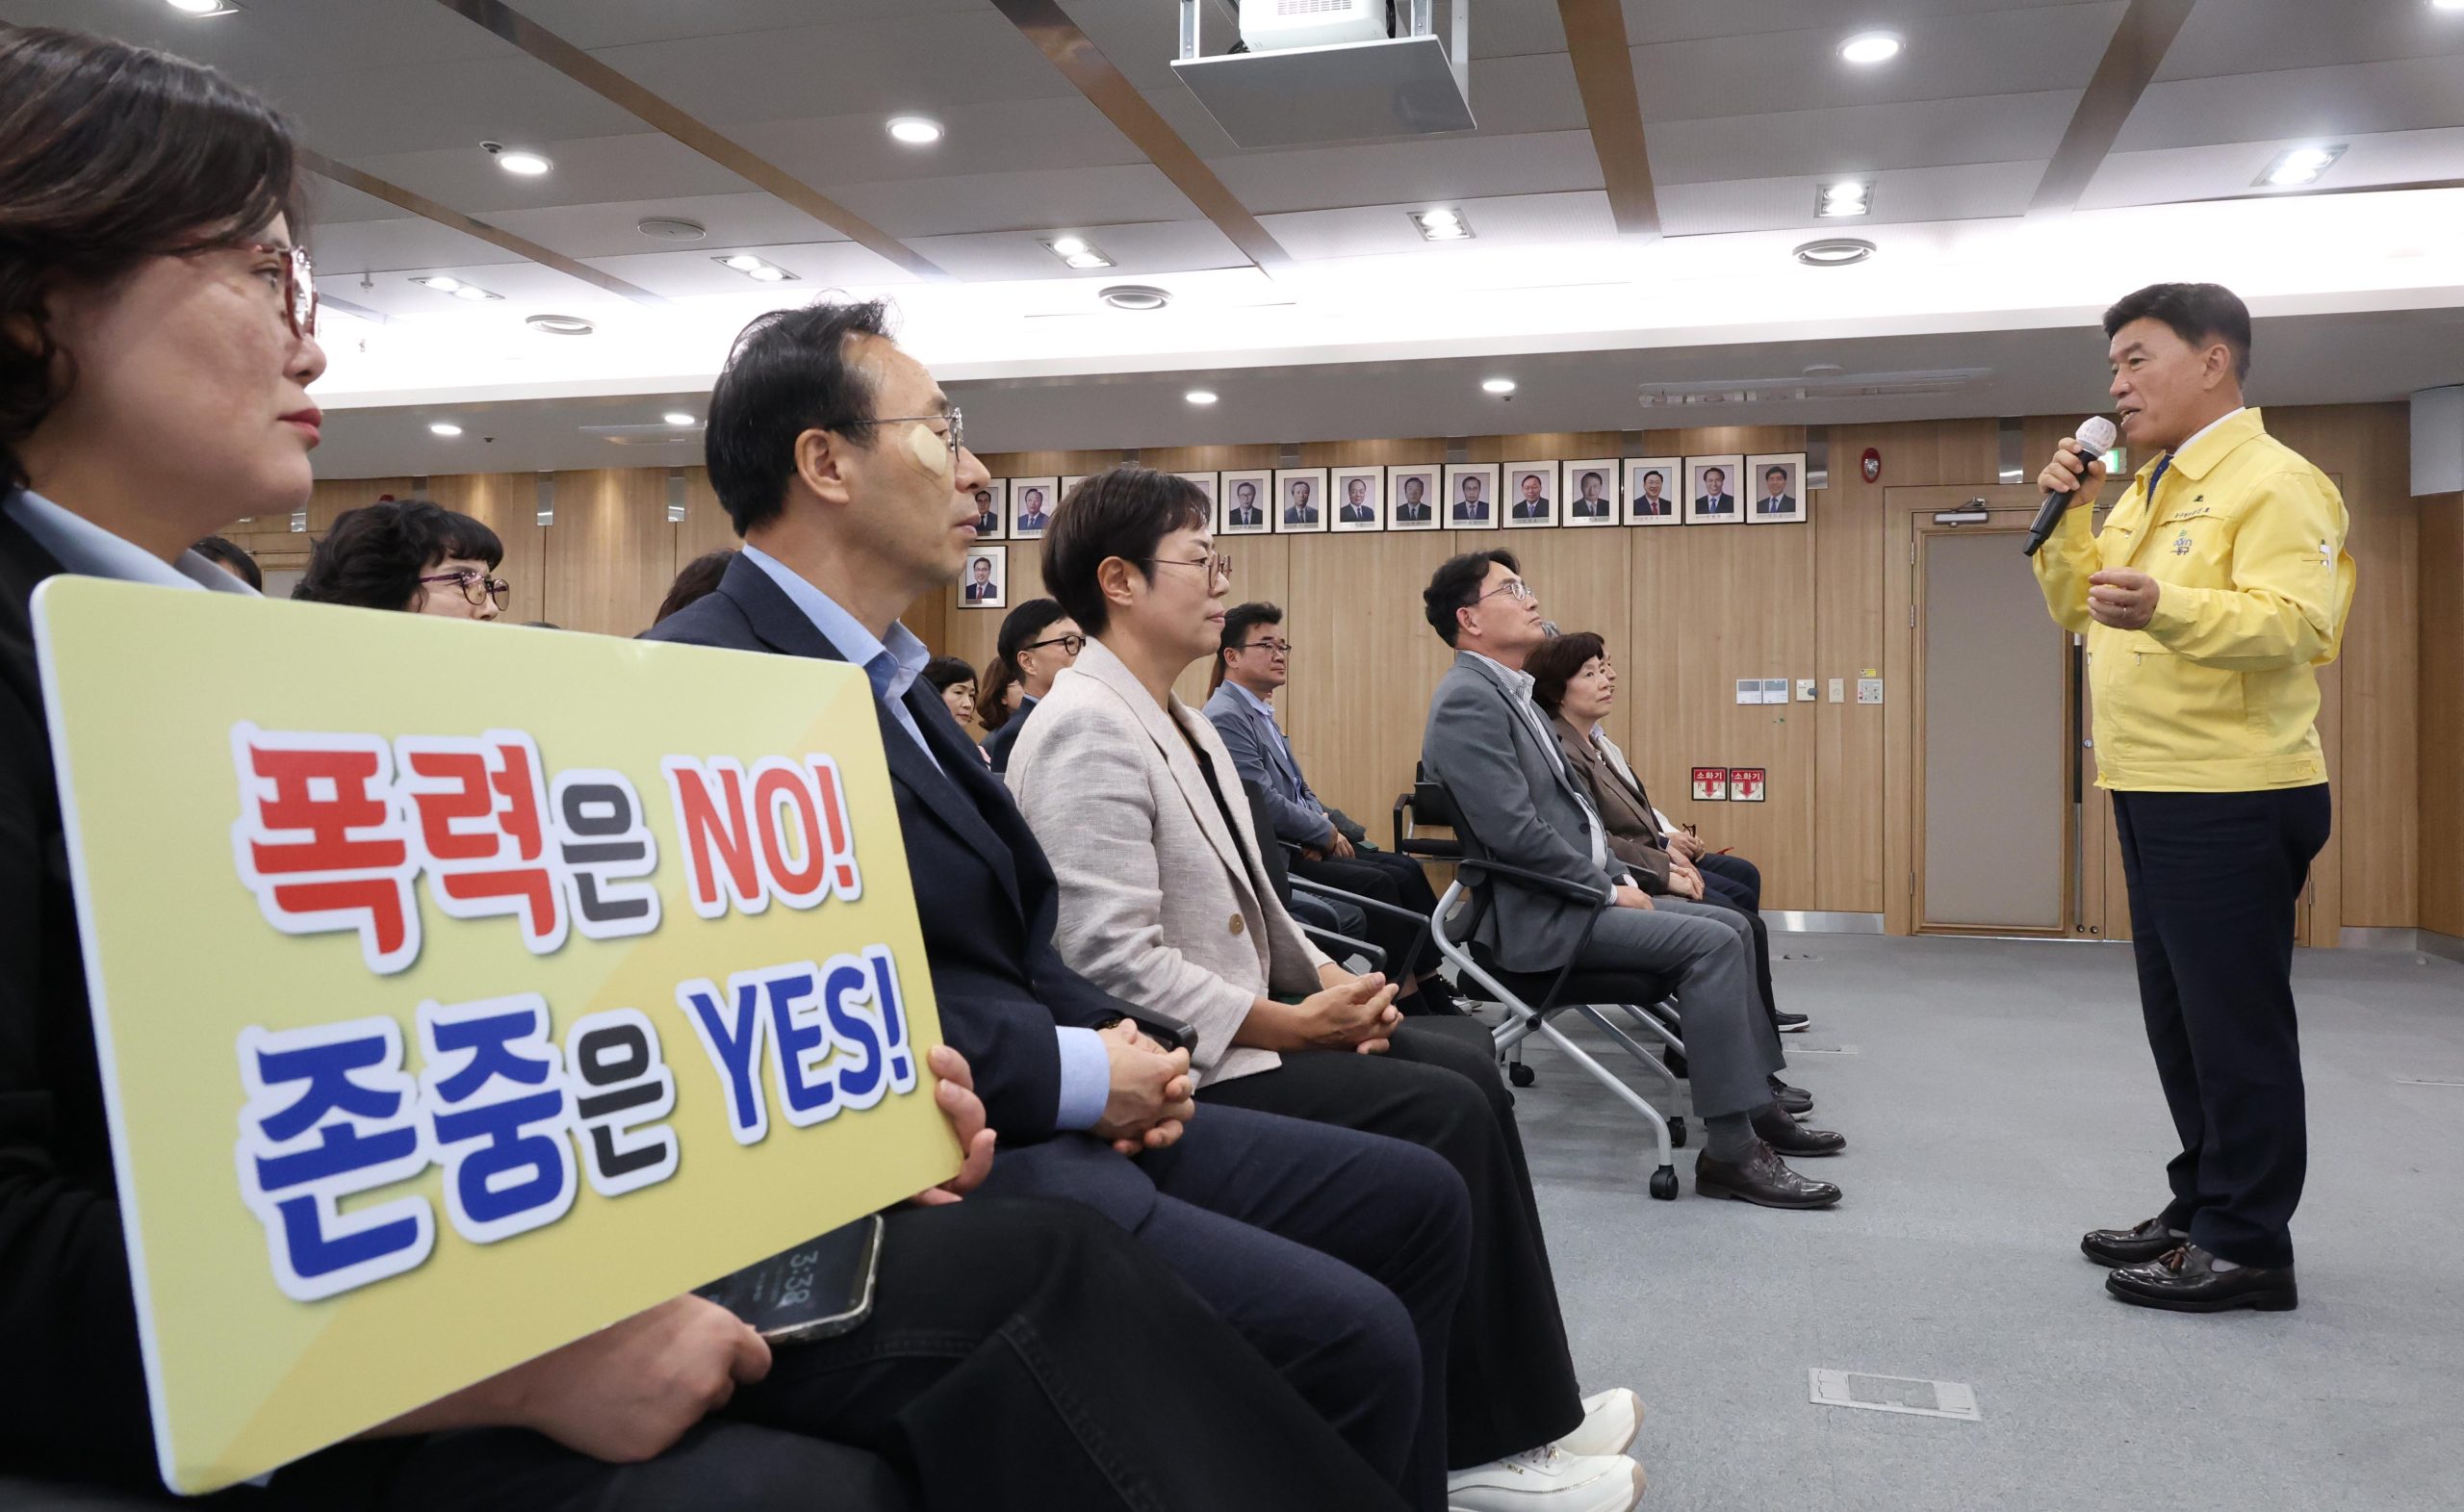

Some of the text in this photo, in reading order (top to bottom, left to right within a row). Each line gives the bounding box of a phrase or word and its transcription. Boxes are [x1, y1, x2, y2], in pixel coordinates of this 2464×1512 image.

[1696, 771, 1722, 780] 소화기
[1733, 772, 1760, 781] 소화기
[249, 742, 854, 955] 폭력은 NO!
[255, 957, 909, 1278] 존중은 YES!
[784, 1250, 819, 1304] 3:38
